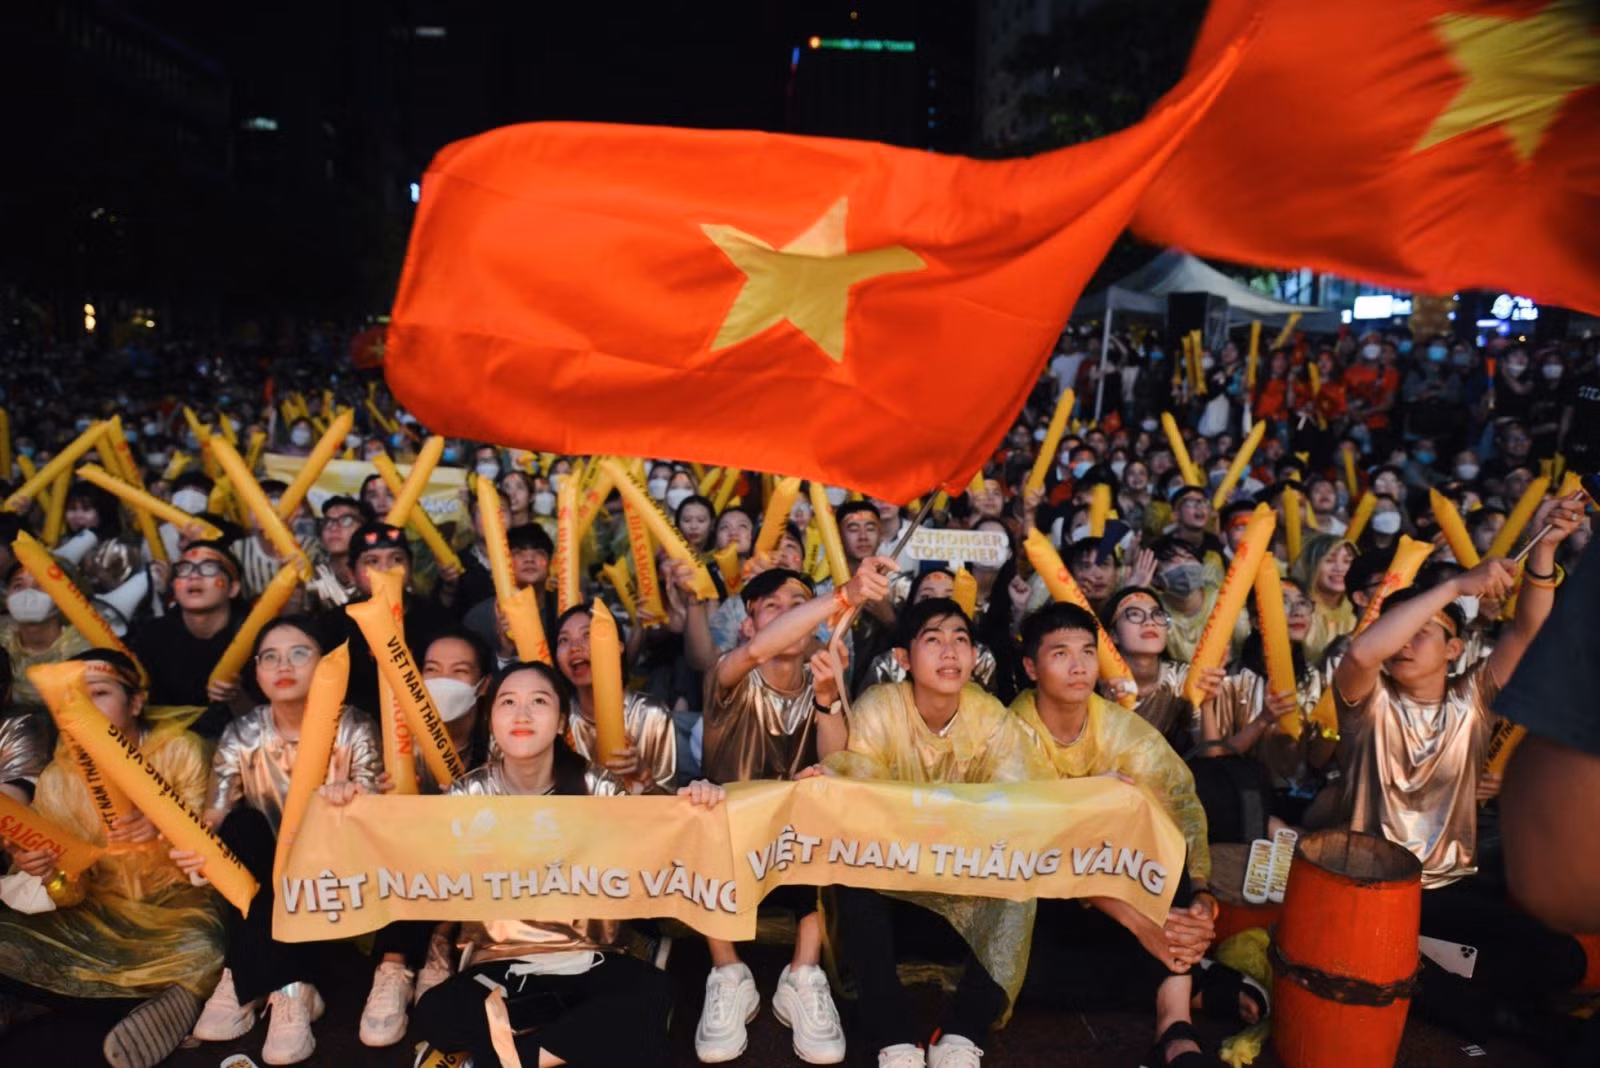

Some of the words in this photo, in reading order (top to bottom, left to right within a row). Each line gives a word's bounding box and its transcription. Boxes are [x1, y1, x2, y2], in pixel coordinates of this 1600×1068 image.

[387, 636, 411, 669] VIỆT
[403, 669, 426, 703] NAM
[107, 723, 145, 765] VÀNG
[282, 868, 369, 922] VIỆT
[377, 866, 475, 900] NAM
[640, 858, 736, 914] VÀNG
[746, 824, 822, 881] VIỆT
[828, 838, 921, 874] NAM
[1072, 841, 1168, 896] VÀNG
